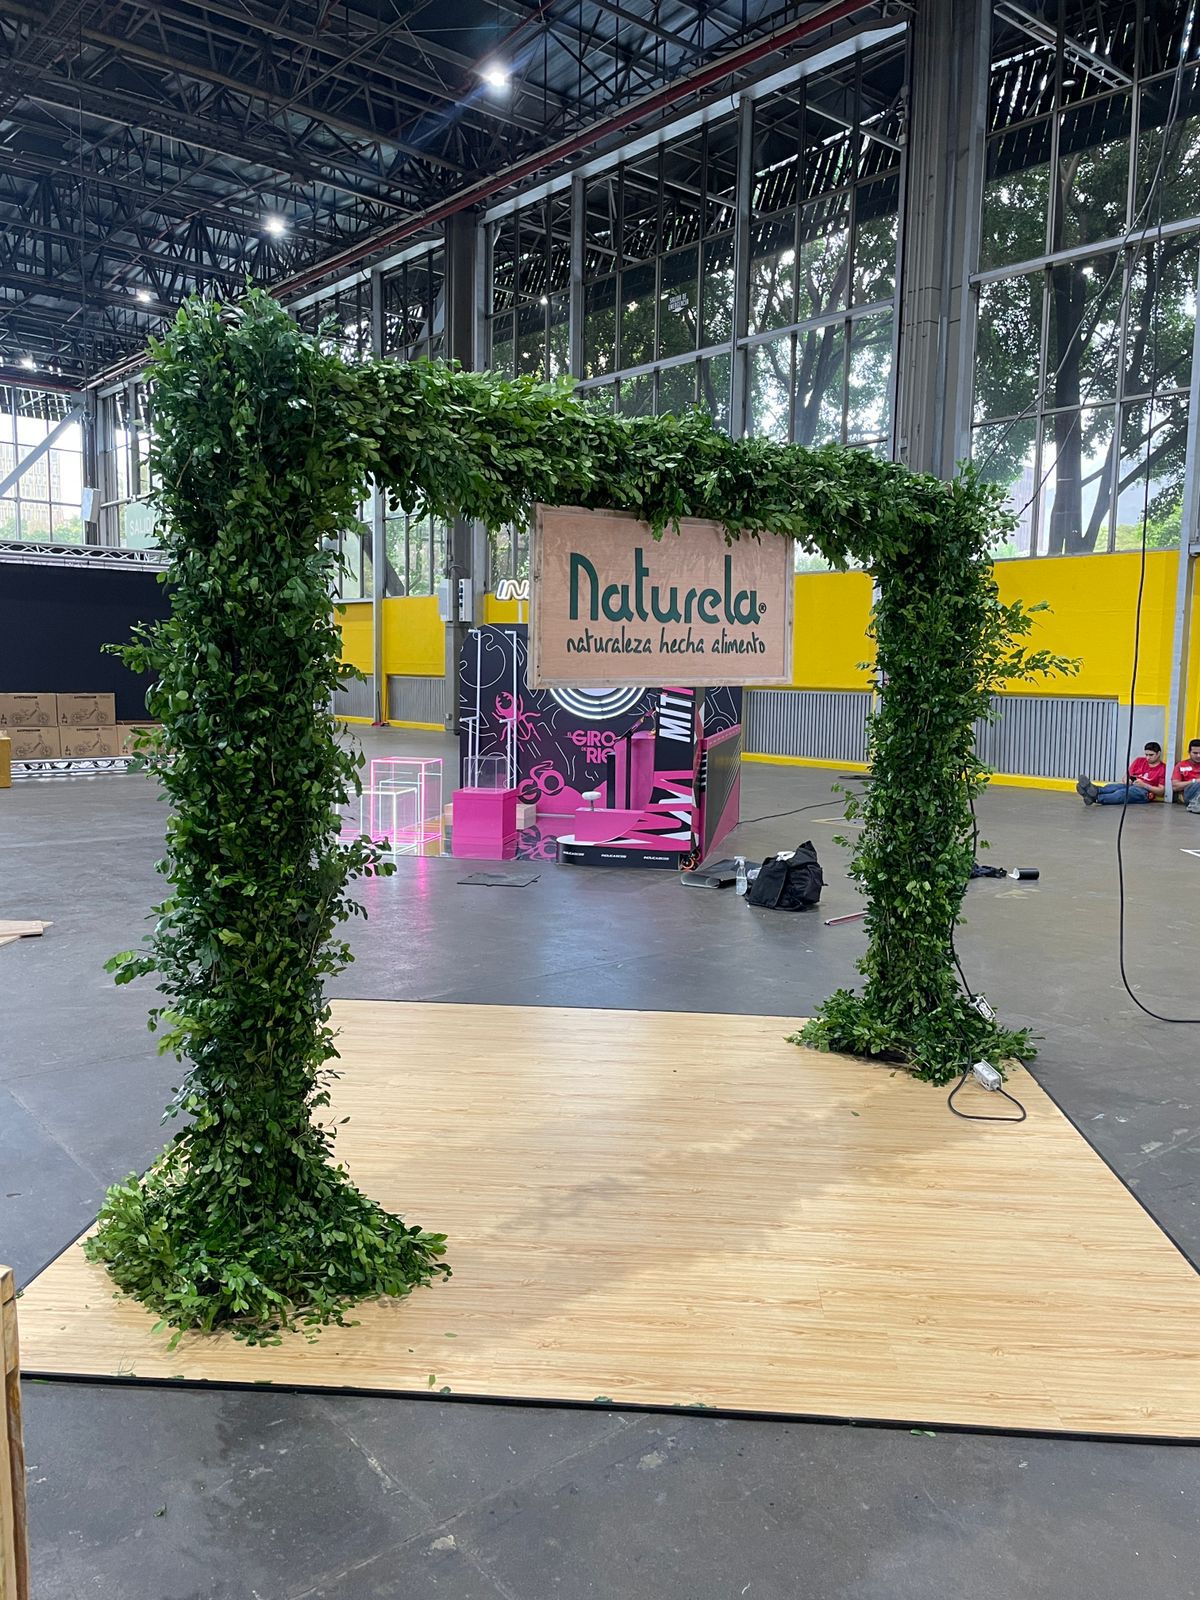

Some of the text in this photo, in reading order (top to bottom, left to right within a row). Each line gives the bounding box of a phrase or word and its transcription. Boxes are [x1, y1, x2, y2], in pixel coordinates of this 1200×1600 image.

[566, 625, 766, 655] naturaleza hecha alimento
[572, 730, 616, 747] GIRO
